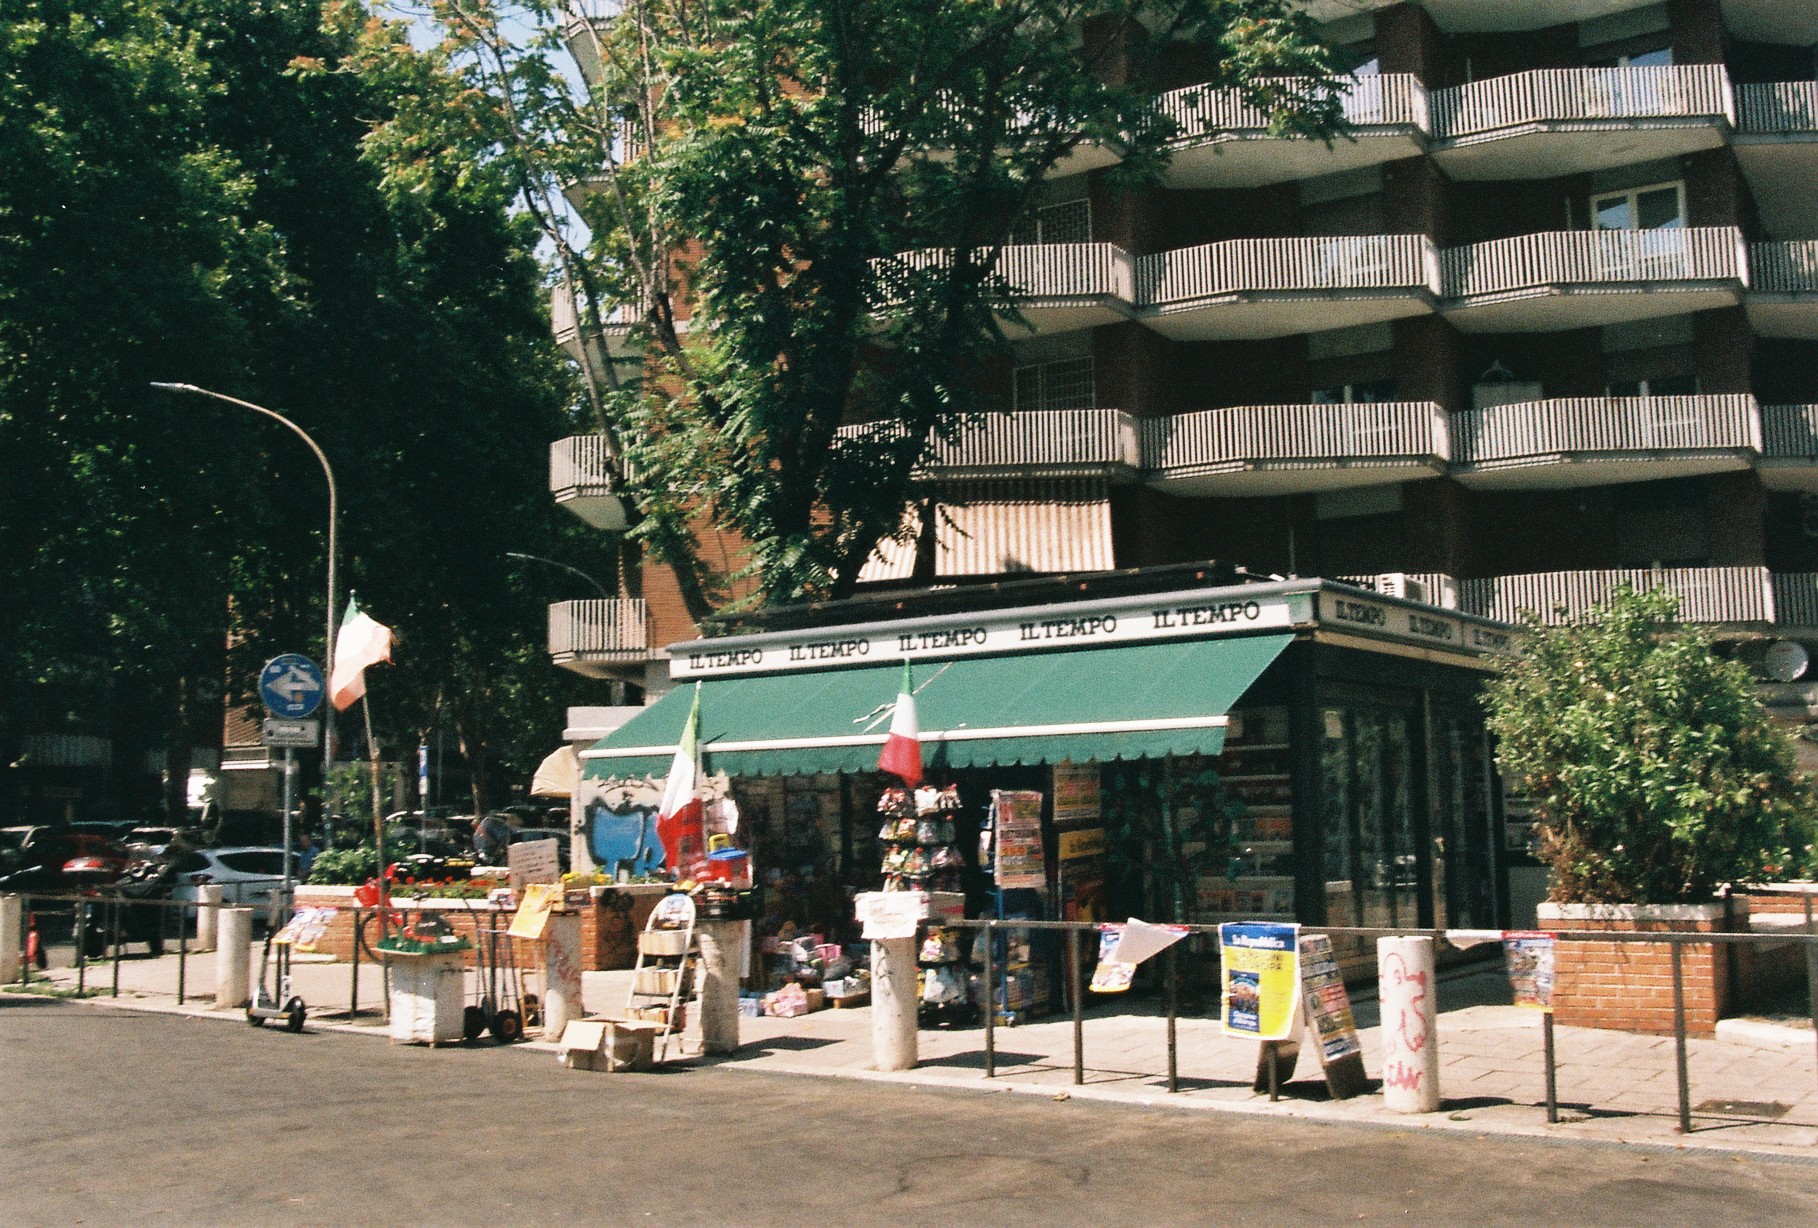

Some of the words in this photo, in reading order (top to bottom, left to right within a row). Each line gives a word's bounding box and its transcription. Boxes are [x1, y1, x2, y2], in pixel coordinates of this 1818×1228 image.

[1153, 609, 1175, 629] IL
[1176, 601, 1260, 626] TEMPO
[1348, 603, 1386, 627] TEMPO
[899, 634, 917, 651] IL
[918, 627, 987, 649] TEMPO
[1020, 623, 1039, 641] IL
[1041, 614, 1117, 639] TEMPO
[689, 654, 704, 669] IL
[706, 649, 763, 668] TEMPO
[789, 645, 805, 661] IL
[807, 639, 870, 659] TEMPO
[1241, 935, 1285, 949] Repubblica
